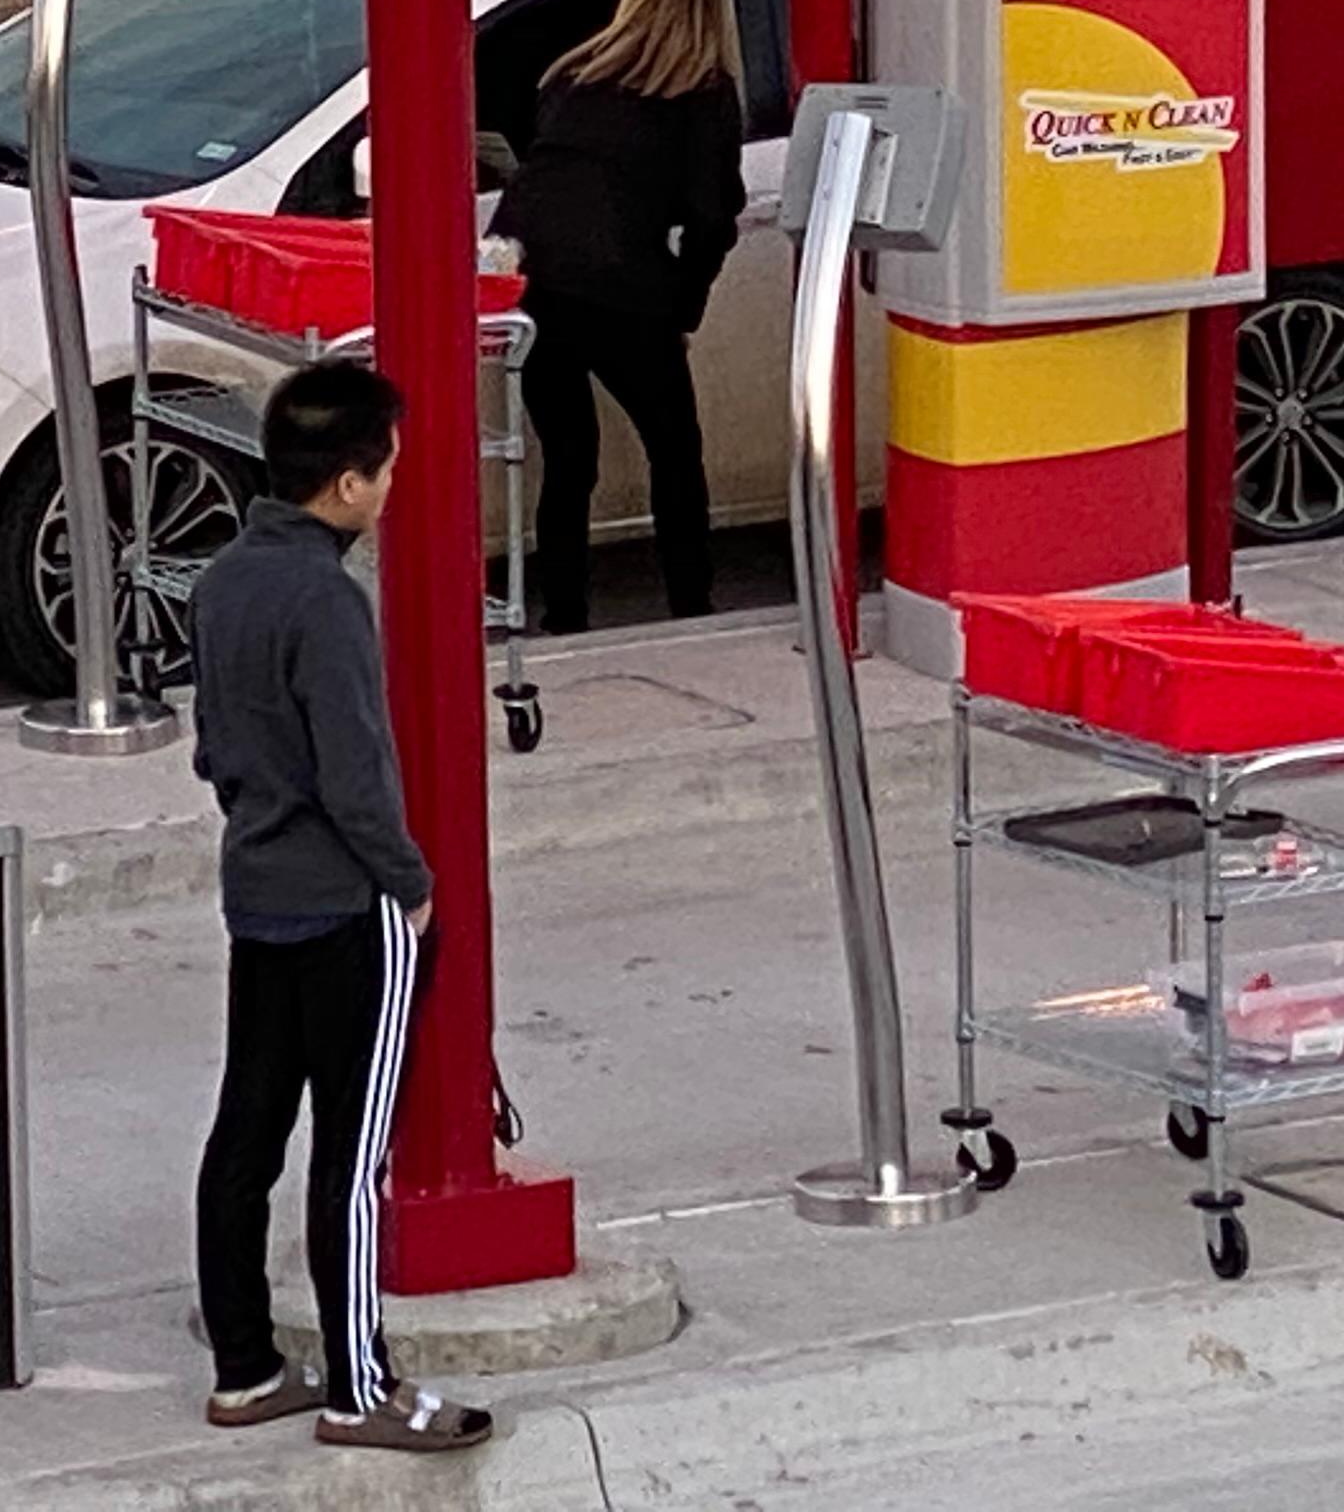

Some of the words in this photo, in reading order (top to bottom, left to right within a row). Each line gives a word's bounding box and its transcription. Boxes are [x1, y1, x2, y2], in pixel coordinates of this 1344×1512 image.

[1031, 110, 1117, 145] QUICK
[1122, 110, 1142, 131] N
[1148, 100, 1230, 130] CLEAN
